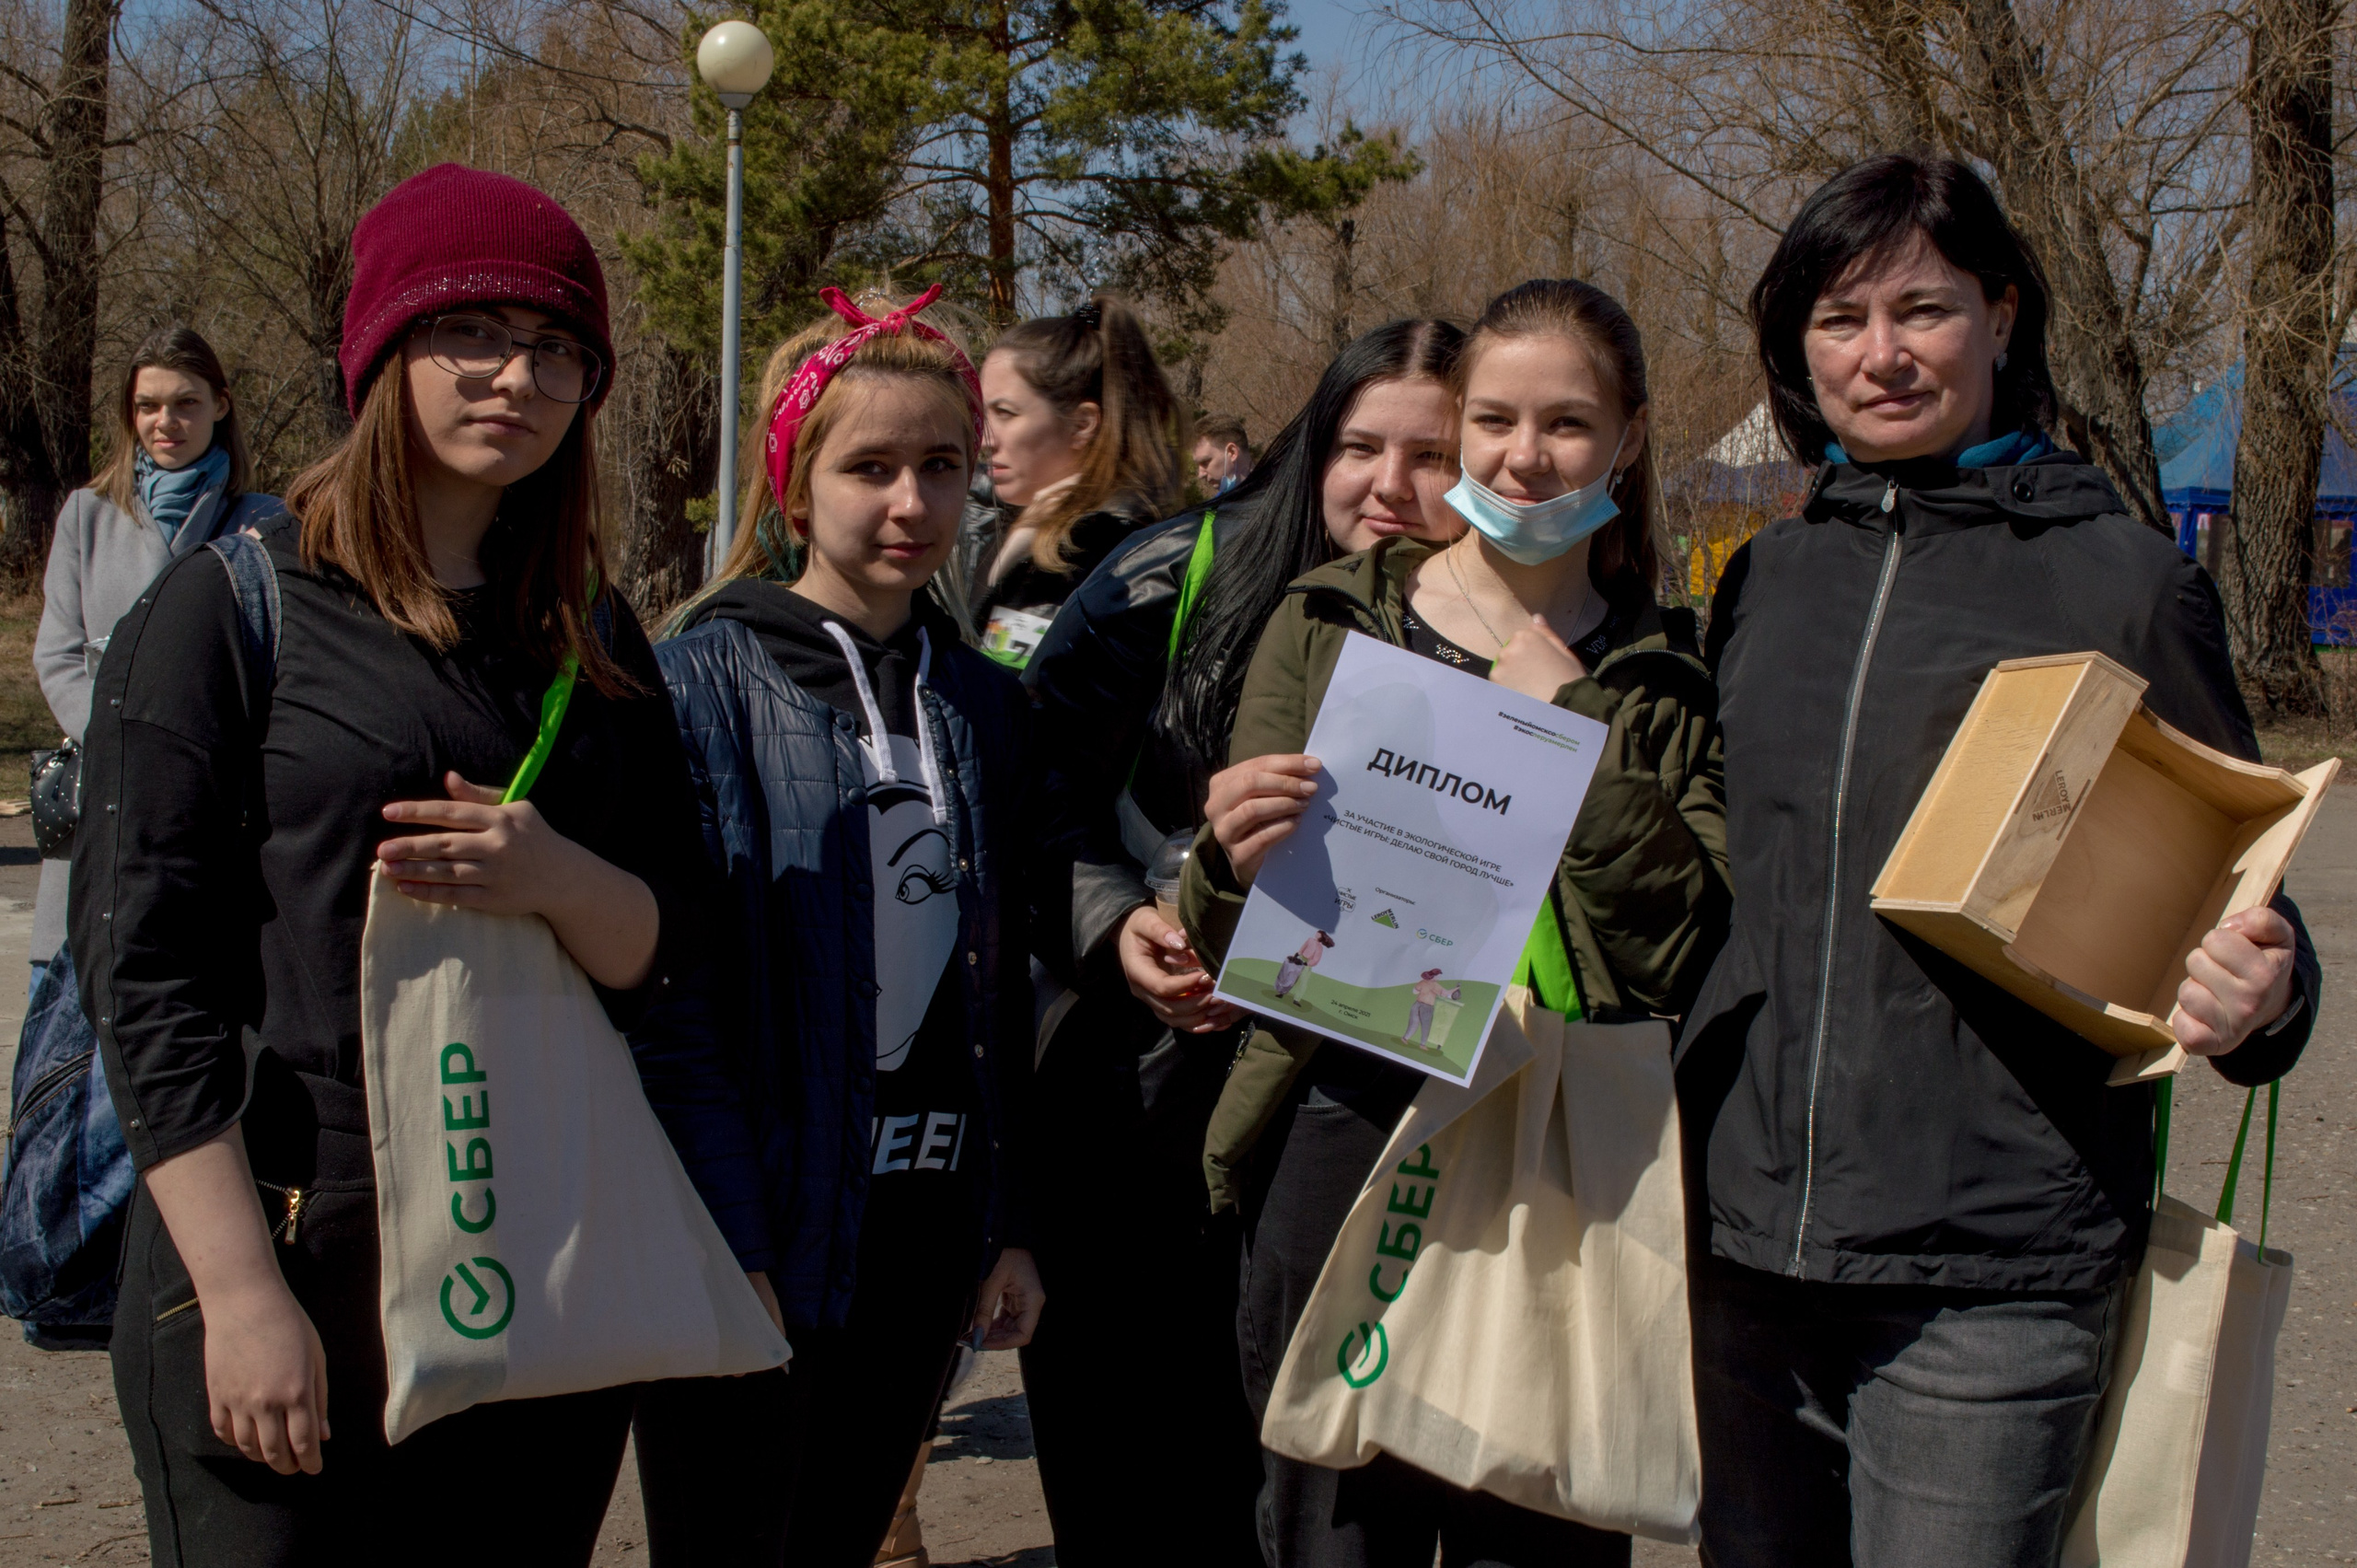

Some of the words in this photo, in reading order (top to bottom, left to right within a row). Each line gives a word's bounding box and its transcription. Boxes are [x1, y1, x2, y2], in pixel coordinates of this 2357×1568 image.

[1366, 748, 1512, 816] ДИПЛОМ
[2055, 770, 2070, 803] LEROY
[2032, 803, 2072, 822] MERLIN
[1323, 814, 1363, 833] «ЧИСТЫЕ
[1364, 828, 1390, 843] ИГРЫ:
[1389, 837, 1423, 854] ДЕЛАЮ
[1423, 849, 1449, 865] СВОЙ
[1449, 858, 1479, 876] ГОРОД
[1479, 869, 1514, 887] ЛУЧШЕ»
[1343, 809, 1355, 819] ЗА
[1356, 814, 1396, 834] УЧАСТИЕ
[1396, 829, 1403, 837] В
[1404, 831, 1479, 864] ЭКОЛОГИЧЕСКОЙ
[1479, 859, 1502, 873] ИГРЕ
[1334, 898, 1354, 910] ИГРЫ
[1375, 887, 1416, 906] Организаторы:
[1371, 910, 1389, 921] LEROY
[1387, 908, 1399, 929] MERLIN
[1429, 934, 1454, 947] СБЕР
[440, 1042, 497, 1235] СБЕР
[870, 1110, 968, 1176] EE
[1369, 1143, 1440, 1304] СБЕР
